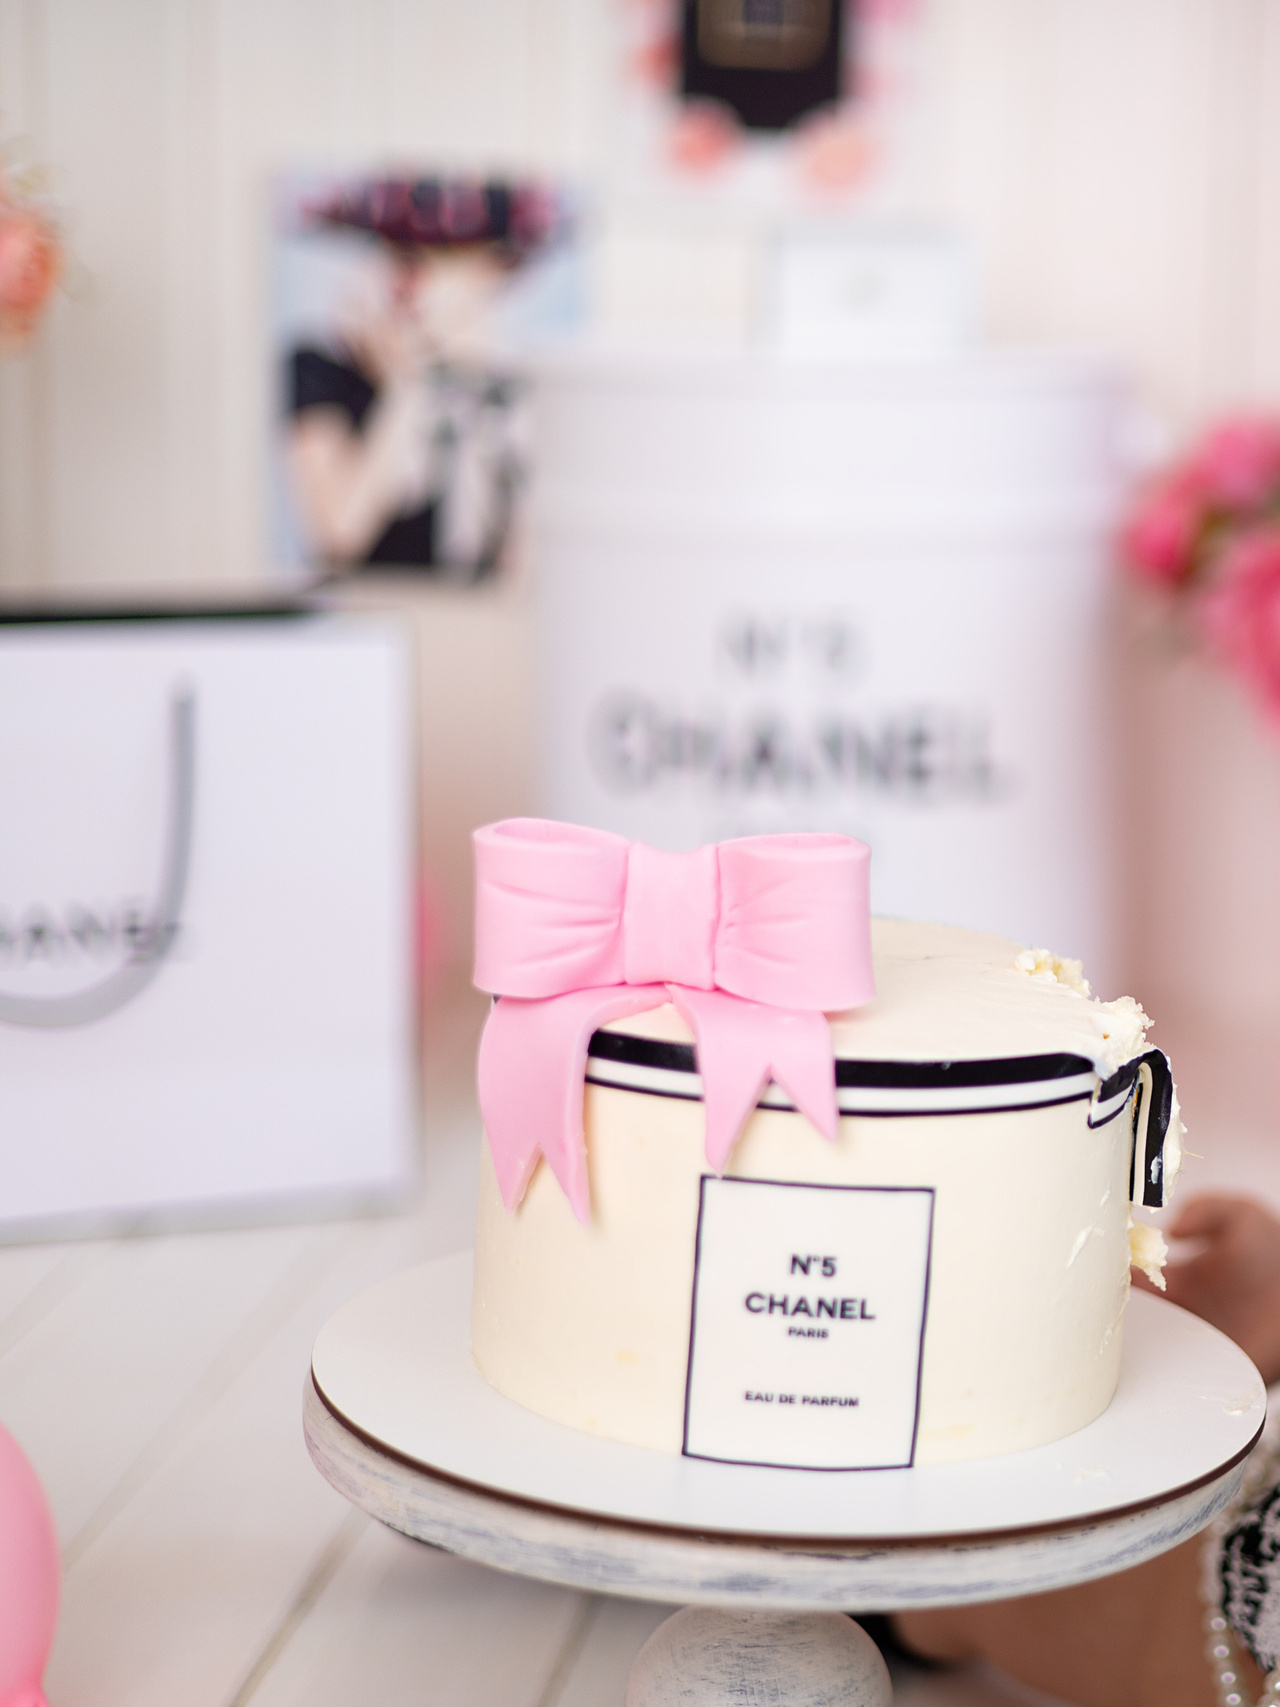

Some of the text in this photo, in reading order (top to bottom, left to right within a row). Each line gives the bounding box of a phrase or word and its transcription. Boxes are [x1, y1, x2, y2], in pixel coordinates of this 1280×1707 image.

[588, 692, 1010, 797] CHANEL
[744, 1290, 876, 1321] CHANEL
[787, 1325, 830, 1340] PARIS
[743, 1389, 860, 1408] EAU DE PARFUM
